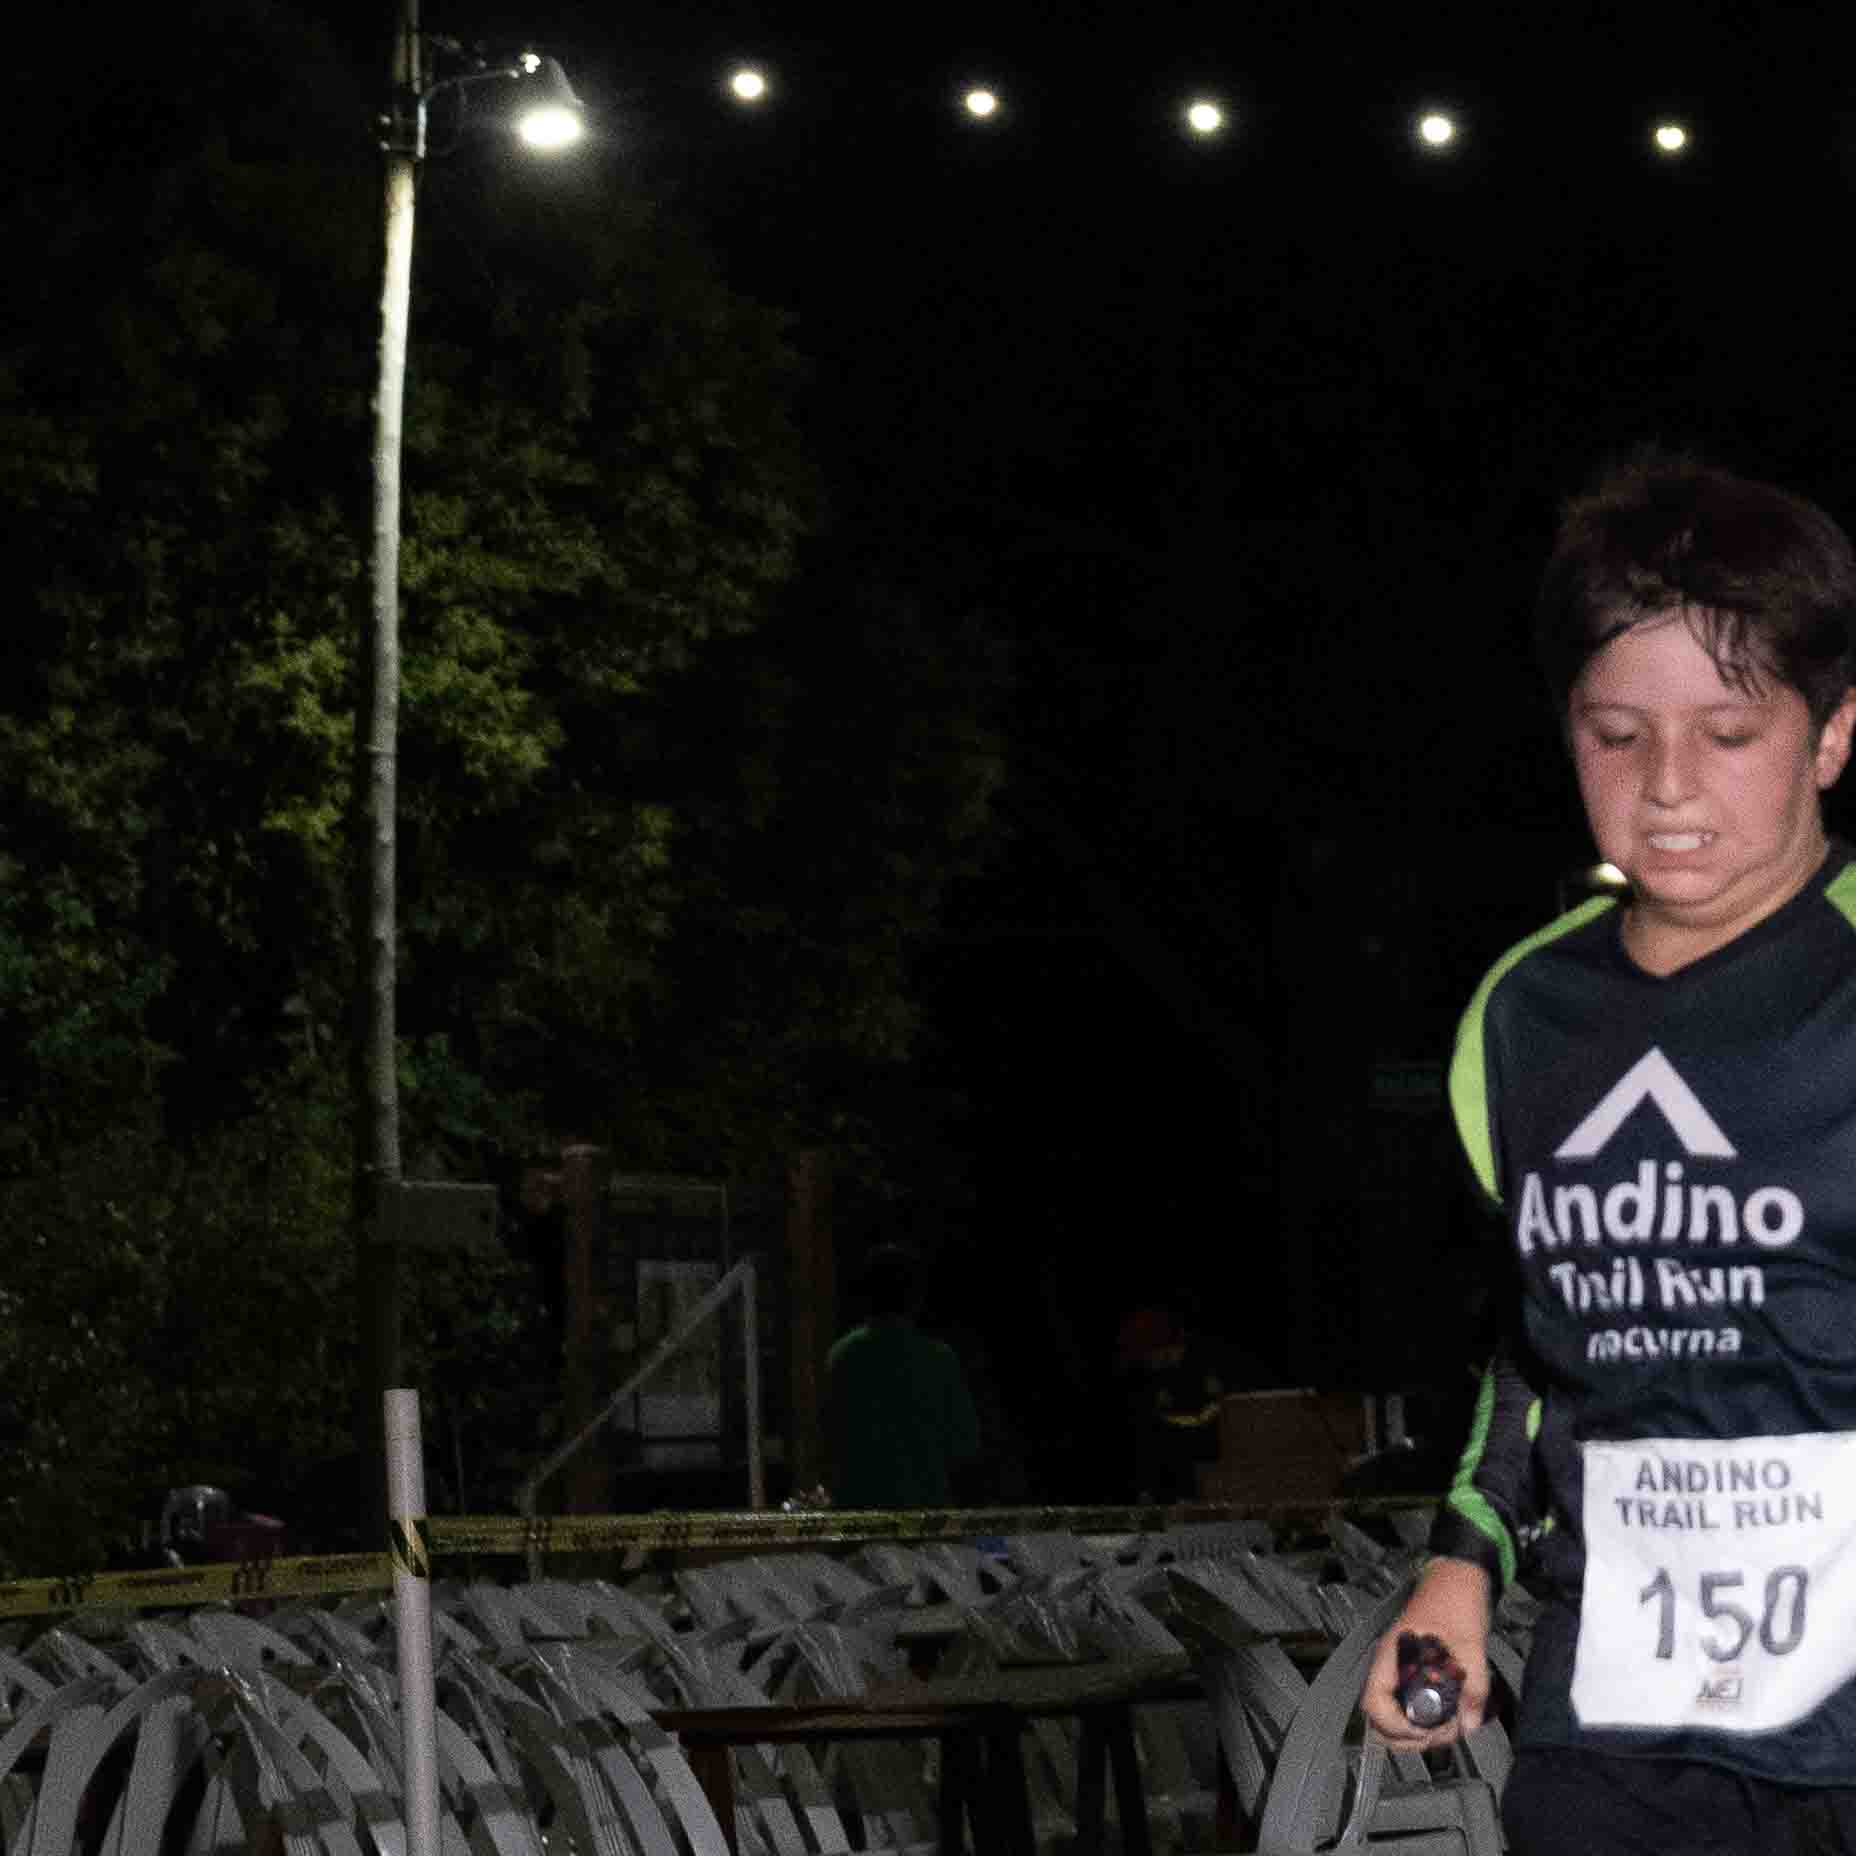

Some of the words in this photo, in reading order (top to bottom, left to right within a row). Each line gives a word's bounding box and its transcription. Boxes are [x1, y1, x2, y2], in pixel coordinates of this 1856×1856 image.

[1517, 1159, 1804, 1257] Andino
[1654, 1257, 1765, 1309] Run
[1634, 1458, 1792, 1493] ANDINO
[1614, 1497, 1721, 1530] TRAIL
[1735, 1491, 1824, 1530] RUN
[1639, 1564, 1809, 1663] 150
